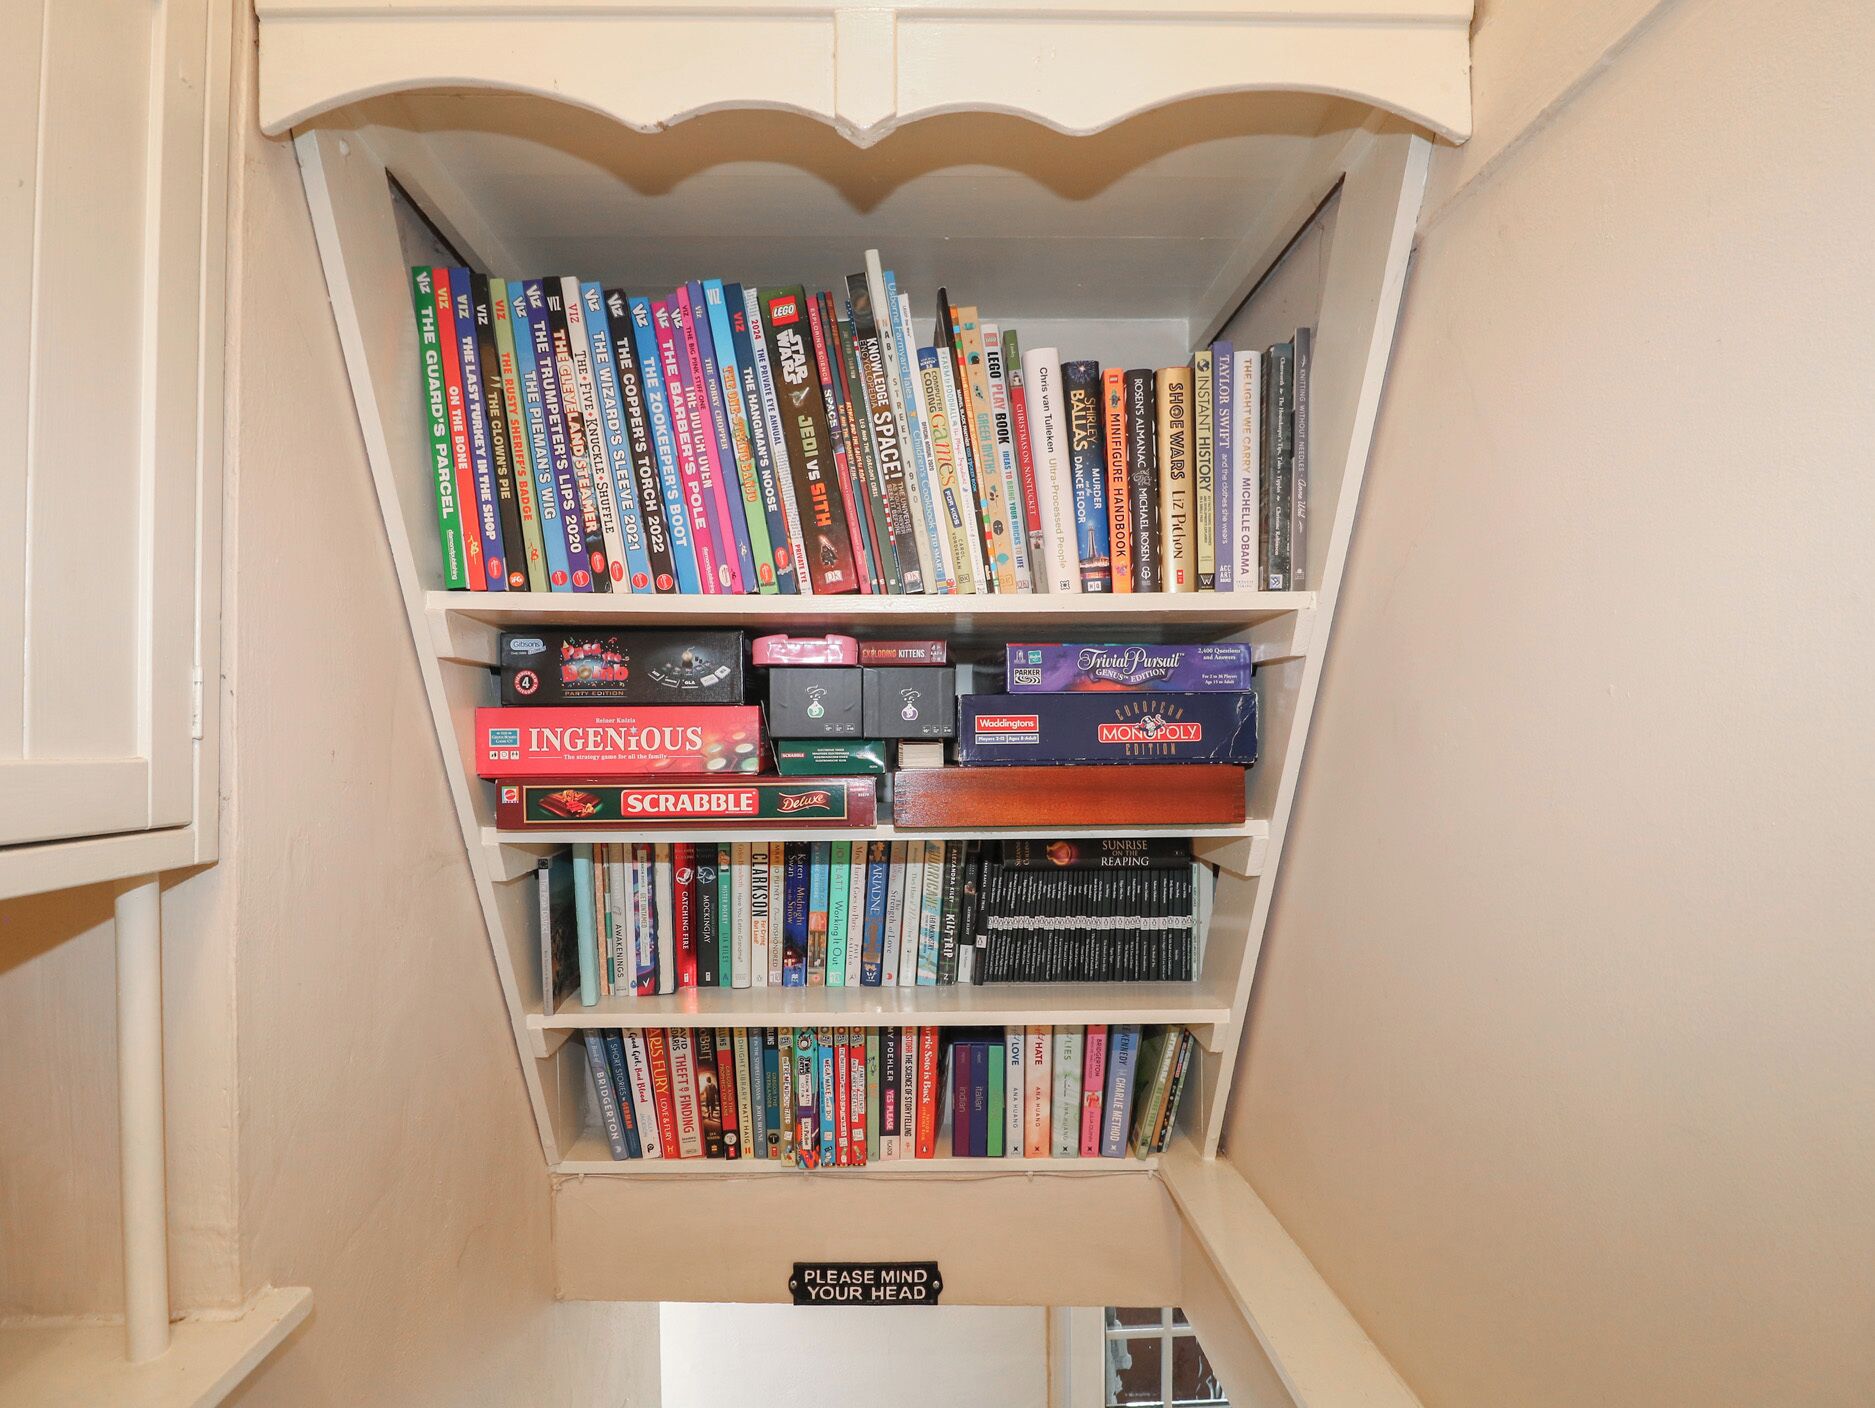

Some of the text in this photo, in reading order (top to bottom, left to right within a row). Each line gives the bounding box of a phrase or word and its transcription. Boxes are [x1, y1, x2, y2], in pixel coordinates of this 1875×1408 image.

[421, 306, 435, 344] THE
[457, 294, 470, 319] VIZ
[477, 304, 489, 325] VIZ
[495, 299, 506, 320] VIZ
[773, 304, 795, 318] LEGO
[776, 330, 799, 384] WARS
[788, 328, 808, 384] STAR
[859, 339, 878, 408] ENCYCLOPEDIA
[867, 337, 890, 407] KNOWLEDGE
[426, 350, 445, 437] GUARD'S
[923, 371, 937, 413] CODING
[931, 370, 944, 412] COMPUTER
[987, 351, 1010, 444] LEGO PLAY BOOK
[1168, 383, 1184, 428] SHOE
[1218, 354, 1230, 448] TAYLOR SWIFT
[449, 386, 468, 469] ON THE BONE
[462, 336, 496, 540] THE LAST TURKEY IN THE SHOP
[501, 352, 532, 521] THE RUSTY SHERIFF'S BADGE
[533, 320, 583, 553] THE TRUMPETER'S LIPS 2020
[553, 329, 568, 362] THE
[576, 459, 598, 534] STEAMER
[575, 350, 614, 534] THE FIVE KNUCKLE SHUFFLE
[593, 331, 640, 551] THE WIZARD'S SLEEVE 2021
[616, 337, 665, 553] THE COPPER'S TORCH 2022
[662, 339, 706, 530] THE BARBER'S POLE
[743, 366, 777, 512] THE HANGMAN'S NOOSE
[1070, 390, 1088, 451] BALLAS
[1085, 397, 1098, 443] SHIRLEY
[1197, 375, 1212, 492] INSTANT HISTORY
[488, 392, 511, 500] THE CLOWN'S PIE
[524, 371, 557, 520] THE PIEMAN'S WIG
[643, 357, 688, 547] THE ZOOKEEPER'S BOOT
[873, 411, 903, 480] SPACE!
[930, 413, 957, 487] Games
[1016, 404, 1036, 515] CHRISTMAS ON NANTUCKET
[1039, 367, 1048, 392] Chris
[1044, 414, 1054, 452] Tulleken
[1049, 458, 1061, 534] Ultra-Processed
[1057, 537, 1066, 568] People
[1134, 378, 1150, 561] ROSEN'S ALMANAC MICHAEL ROSEN
[1169, 430, 1186, 480] WARS
[1240, 358, 1253, 575] THE LIGHT WE CARRY MICHELLE OBAMA
[436, 443, 454, 519] PARCEL
[798, 415, 832, 527] JEDI VS SITH
[1074, 456, 1086, 523] DANCE FLOOR
[1092, 468, 1102, 509] MURDER
[1110, 413, 1126, 557] MINIFIGURE HANDBOOK
[944, 490, 961, 526] FOR KIDS
[862, 648, 925, 658] EXPLODING KITTENS
[1077, 647, 1181, 675] Trivial Pursuit
[1095, 668, 1166, 683] GENUS EDITION
[522, 676, 531, 689] 4
[979, 718, 1034, 729] Waddingtons
[1114, 700, 1185, 721] EUROPEAN
[1125, 743, 1176, 755] EDITION
[627, 793, 753, 813] SCRABBLE
[782, 794, 825, 810] Deluxe
[1101, 857, 1150, 866] REAPING
[1102, 840, 1149, 850] SUNRISE
[752, 853, 768, 917] CLARKSON
[870, 864, 883, 915] ARIADNE
[682, 891, 690, 931] CATCHING
[702, 895, 712, 943] MOCKINGJAY
[831, 900, 844, 937] Working
[944, 914, 956, 958] KILT TRIP
[615, 923, 624, 978] AWAKENINGS
[832, 948, 843, 965] Out
[652, 1060, 669, 1095] FURY
[675, 1054, 689, 1085] THEFT
[886, 1041, 894, 1082] POEHLER
[1011, 1042, 1020, 1066] LOVE
[1034, 1042, 1044, 1066] HATE
[596, 1072, 620, 1140] BRIDGERTON
[680, 1095, 695, 1133] FINDING
[886, 1090, 894, 1131] YES PLEASE
[1110, 1078, 1126, 1142] CHARLIE METHOD
[804, 1269, 928, 1284] PLEASE MIND
[807, 1286, 926, 1300] YOUR HEAD
